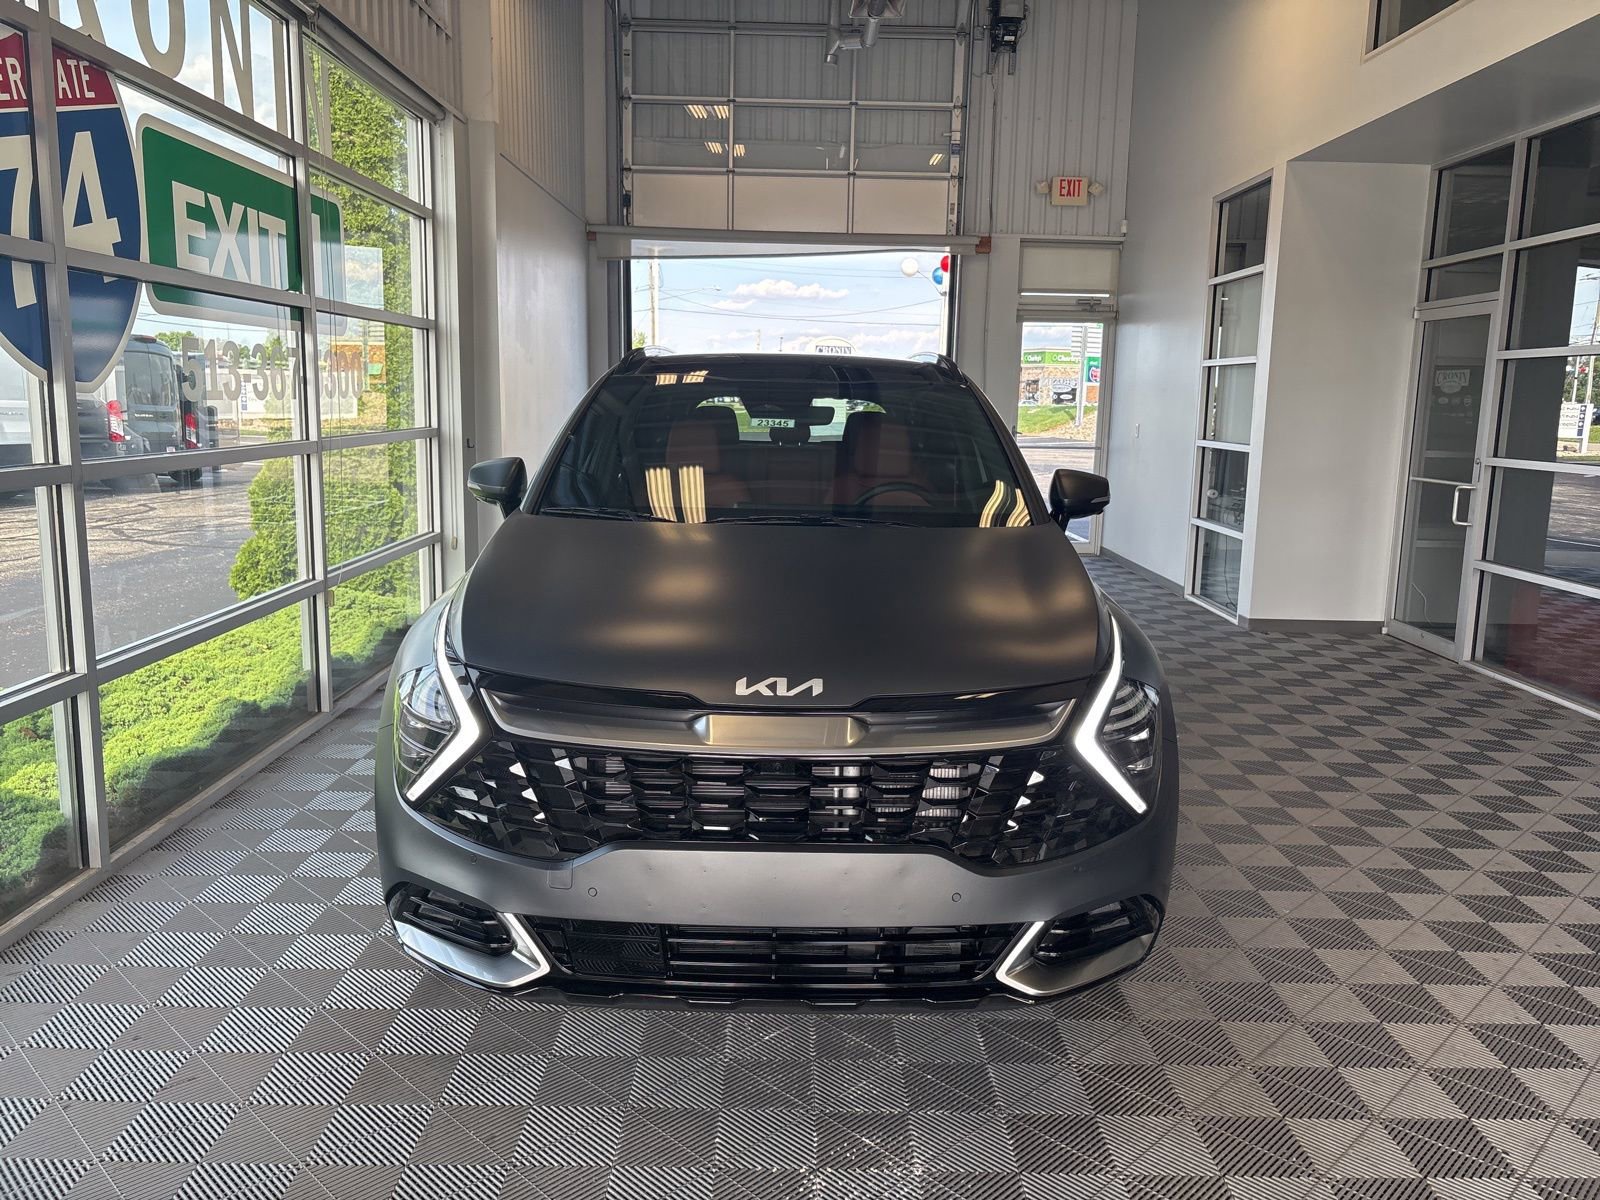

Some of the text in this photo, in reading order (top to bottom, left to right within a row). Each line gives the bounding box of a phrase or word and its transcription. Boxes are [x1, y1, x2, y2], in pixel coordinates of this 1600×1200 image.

[1059, 179, 1083, 197] EXIT
[172, 180, 289, 291] EXIT
[757, 419, 789, 427] 23345
